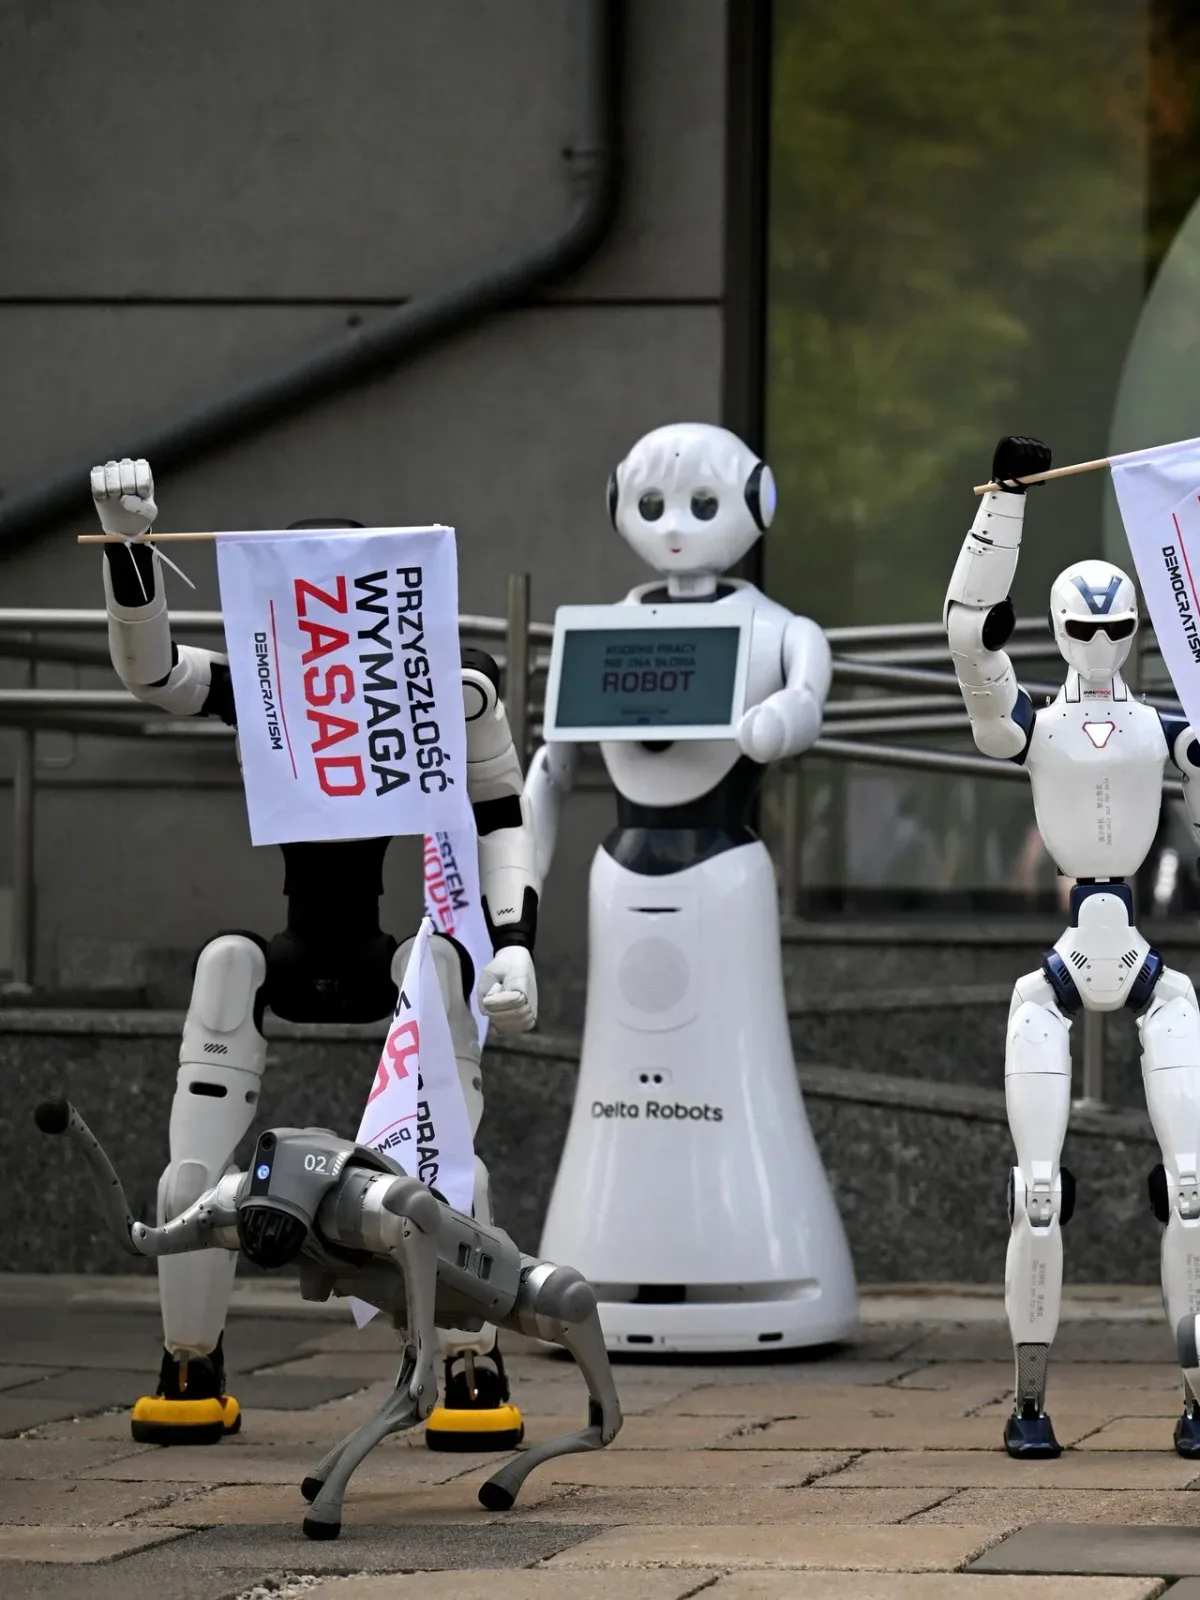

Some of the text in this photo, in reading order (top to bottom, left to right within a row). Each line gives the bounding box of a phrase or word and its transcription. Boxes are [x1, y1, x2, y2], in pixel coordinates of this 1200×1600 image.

[254, 632, 284, 750] DEMOCRATISM
[294, 575, 367, 797] ZASAD
[353, 570, 411, 797] WYMAGA
[396, 566, 455, 794] PRZYSZŁOŚĆ
[602, 670, 696, 693] ROBOT
[304, 1154, 327, 1173] 02
[591, 1101, 724, 1122] Delta Robots
